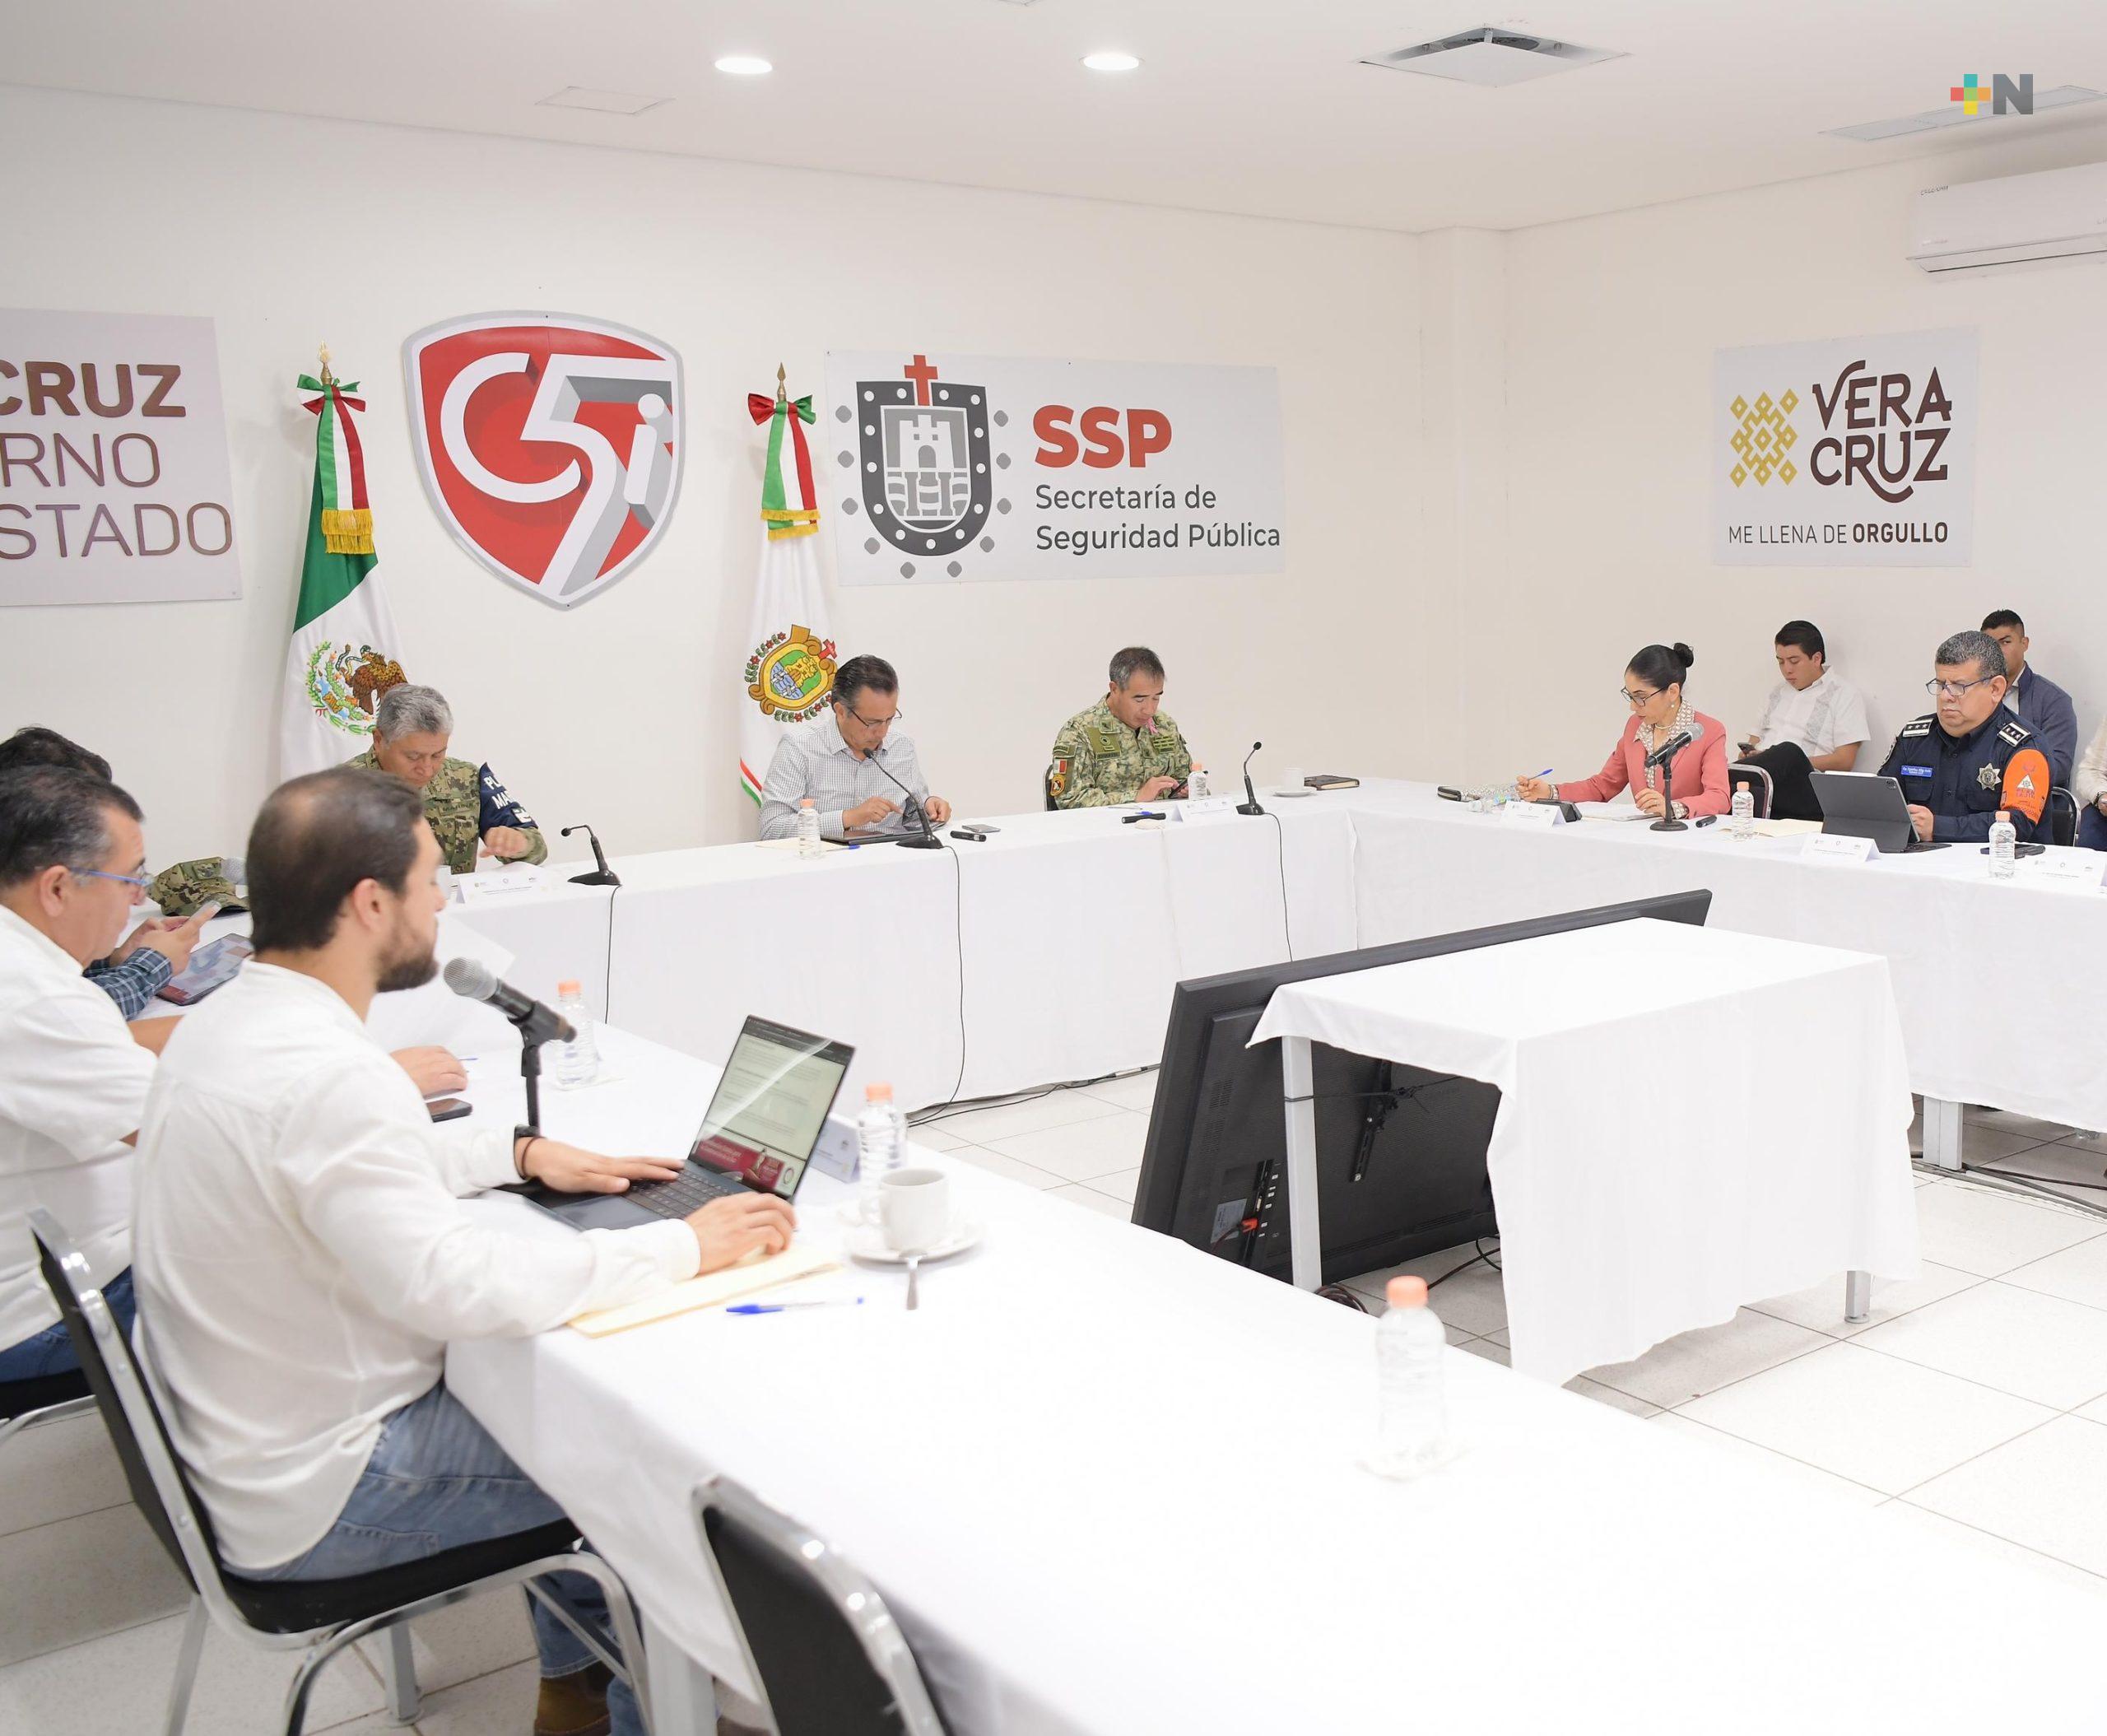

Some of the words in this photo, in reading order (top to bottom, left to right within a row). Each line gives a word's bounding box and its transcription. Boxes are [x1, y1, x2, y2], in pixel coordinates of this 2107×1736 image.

[1812, 360, 1952, 431] VERA
[1032, 404, 1172, 468] SSP
[1811, 428, 1951, 503] CRUZ
[1035, 484, 1176, 510] Secretaría
[1184, 484, 1216, 509] de
[1036, 523, 1179, 556] Seguridad
[1189, 522, 1281, 547] Pública
[1729, 526, 1753, 543] ME
[1760, 524, 1817, 543] LLENA
[1824, 524, 1847, 543] DE
[1853, 522, 1948, 543] ORGULLO
